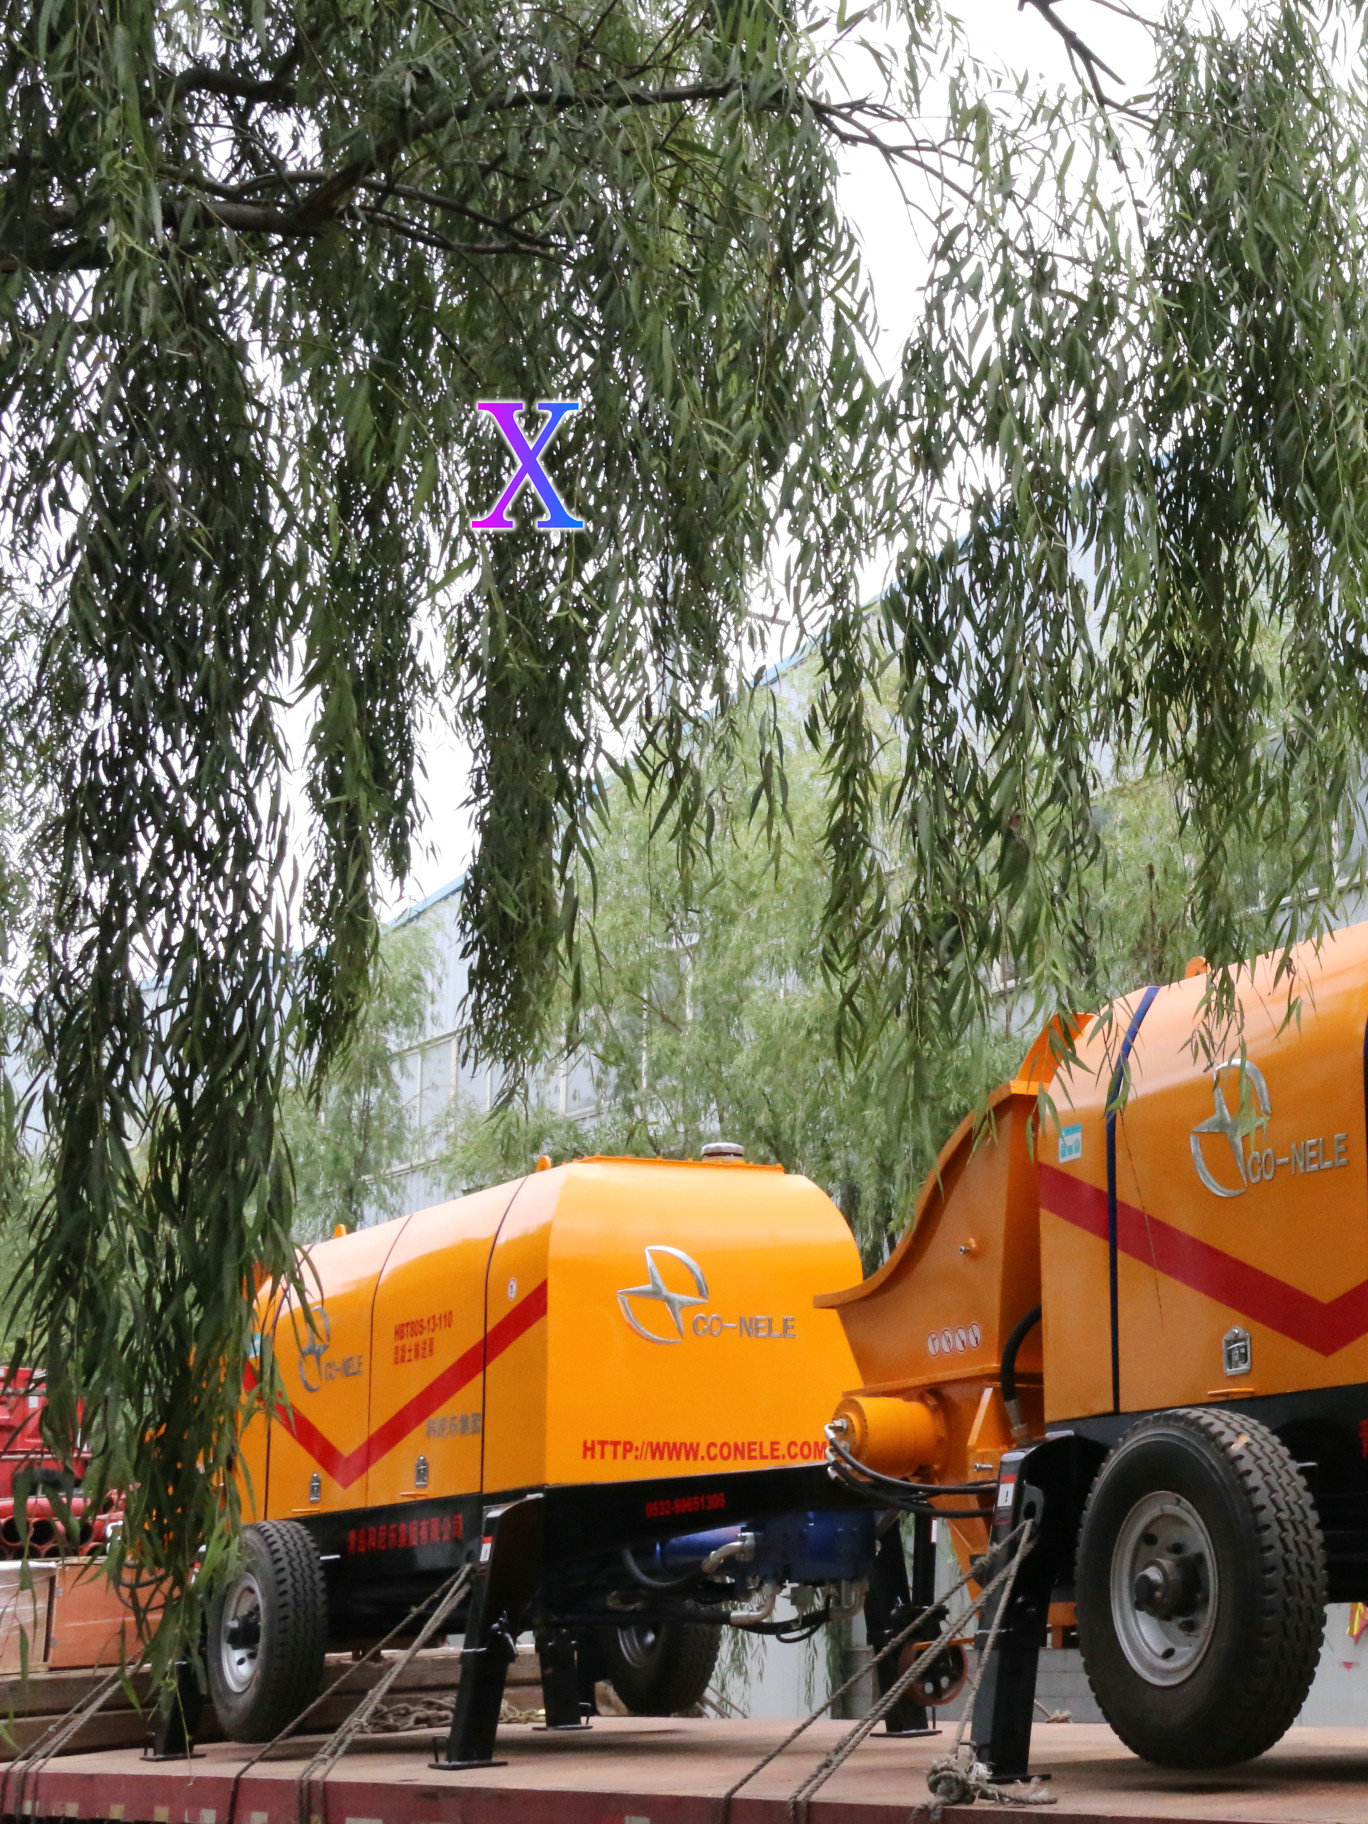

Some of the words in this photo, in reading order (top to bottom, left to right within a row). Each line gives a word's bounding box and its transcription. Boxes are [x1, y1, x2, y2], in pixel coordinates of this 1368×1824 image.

[1248, 1132, 1349, 1185] CO-NELE
[693, 1313, 796, 1338] CO-NELE
[582, 1439, 828, 1461] HTTP://WWW.CONELE.COM
